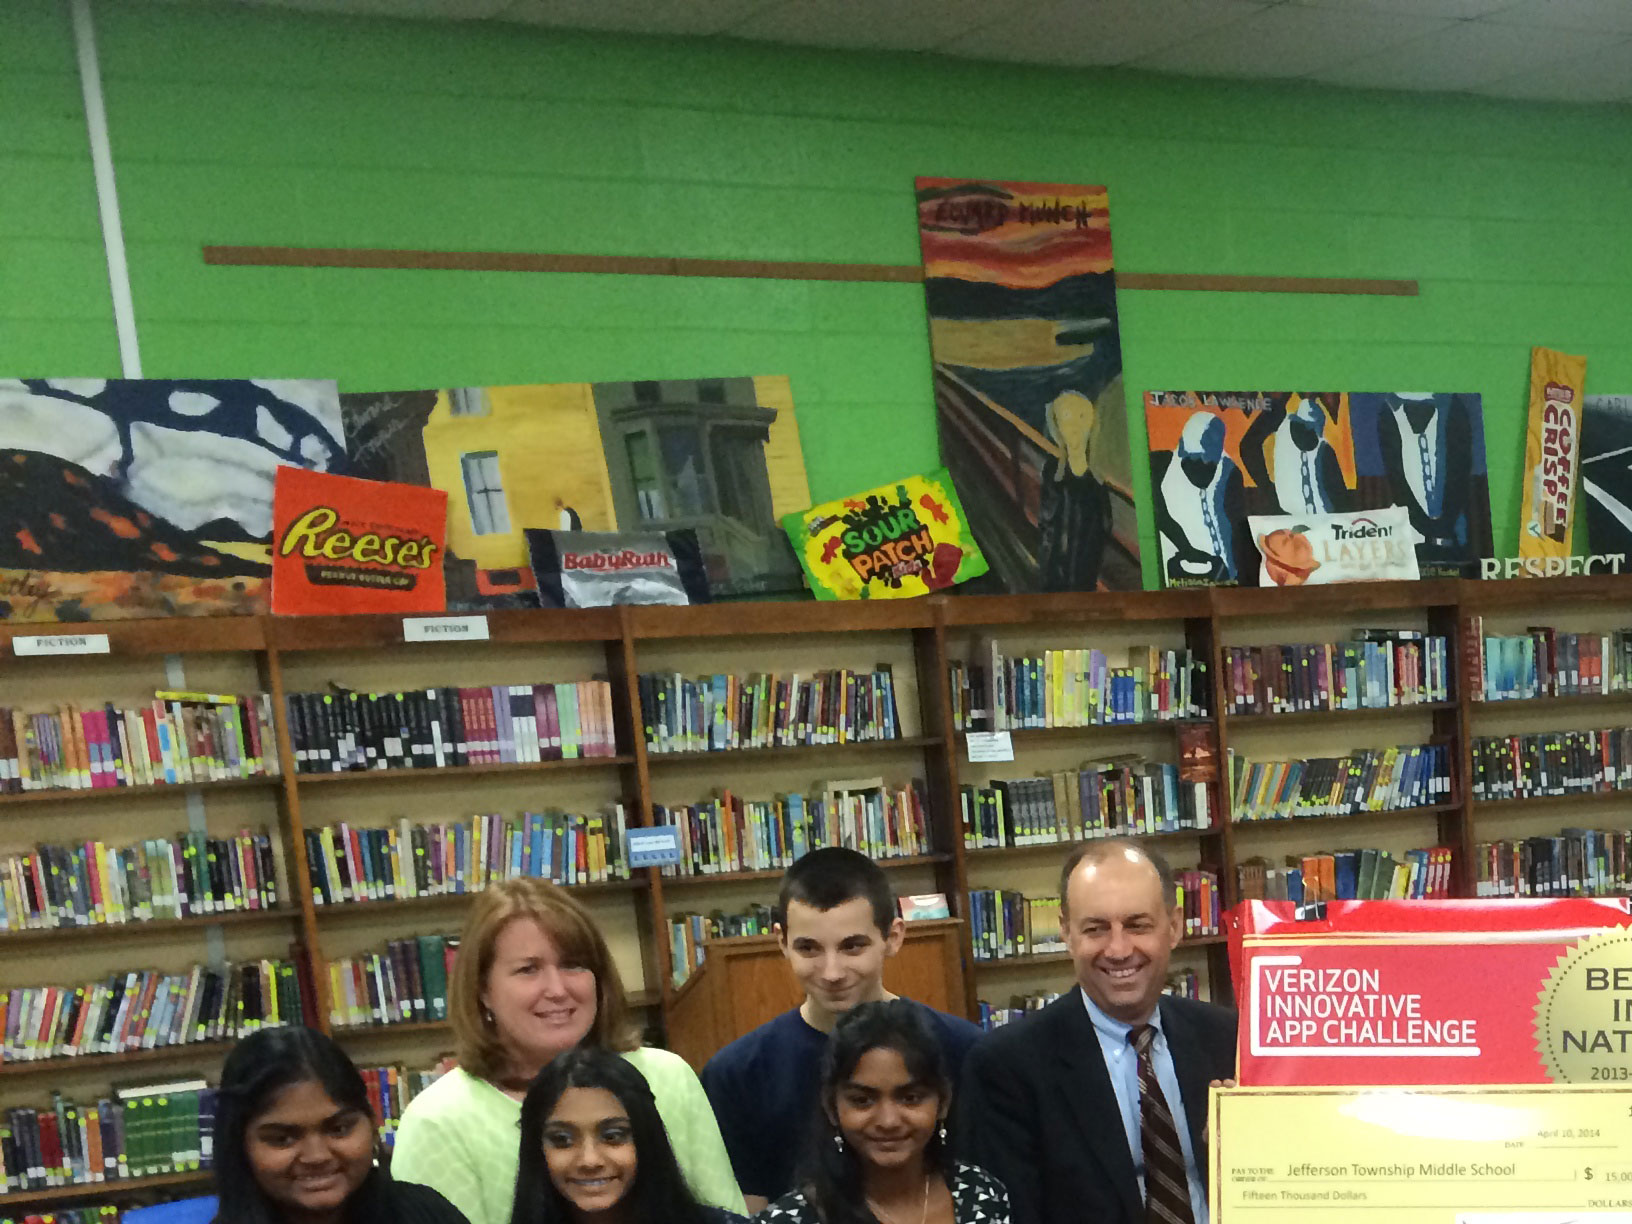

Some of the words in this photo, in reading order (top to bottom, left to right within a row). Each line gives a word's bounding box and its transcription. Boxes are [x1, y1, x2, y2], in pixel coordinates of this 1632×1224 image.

[1543, 404, 1559, 497] CRISP
[1556, 408, 1572, 525] COFFEE
[282, 507, 437, 569] Reese's
[843, 508, 919, 553] SOUR
[1331, 522, 1392, 541] Trident
[851, 529, 933, 580] PATCH
[1323, 540, 1407, 563] LAYERS
[1480, 553, 1626, 580] RESPECT
[424, 624, 469, 633] FICTION
[37, 637, 87, 647] FICTION
[1265, 968, 1380, 993] VERIZON
[1266, 994, 1421, 1018] INNOVATIVE
[1266, 1020, 1318, 1043] APP
[1322, 1020, 1477, 1044] CHALLENGE
[1505, 1141, 1524, 1149] DATE
[1537, 1129, 1559, 1139] April
[1561, 1129, 1576, 1139] 10,
[1578, 1128, 1600, 1138] 2014
[1287, 1163, 1347, 1177] Jefferson
[1351, 1163, 1415, 1178] Township
[1419, 1163, 1467, 1176] Middle
[1471, 1163, 1516, 1176] School
[1584, 1166, 1594, 1181] $
[1242, 1190, 1277, 1200] Fifteen
[1281, 1190, 1329, 1200] Thousand
[1333, 1190, 1367, 1200] Dollars
